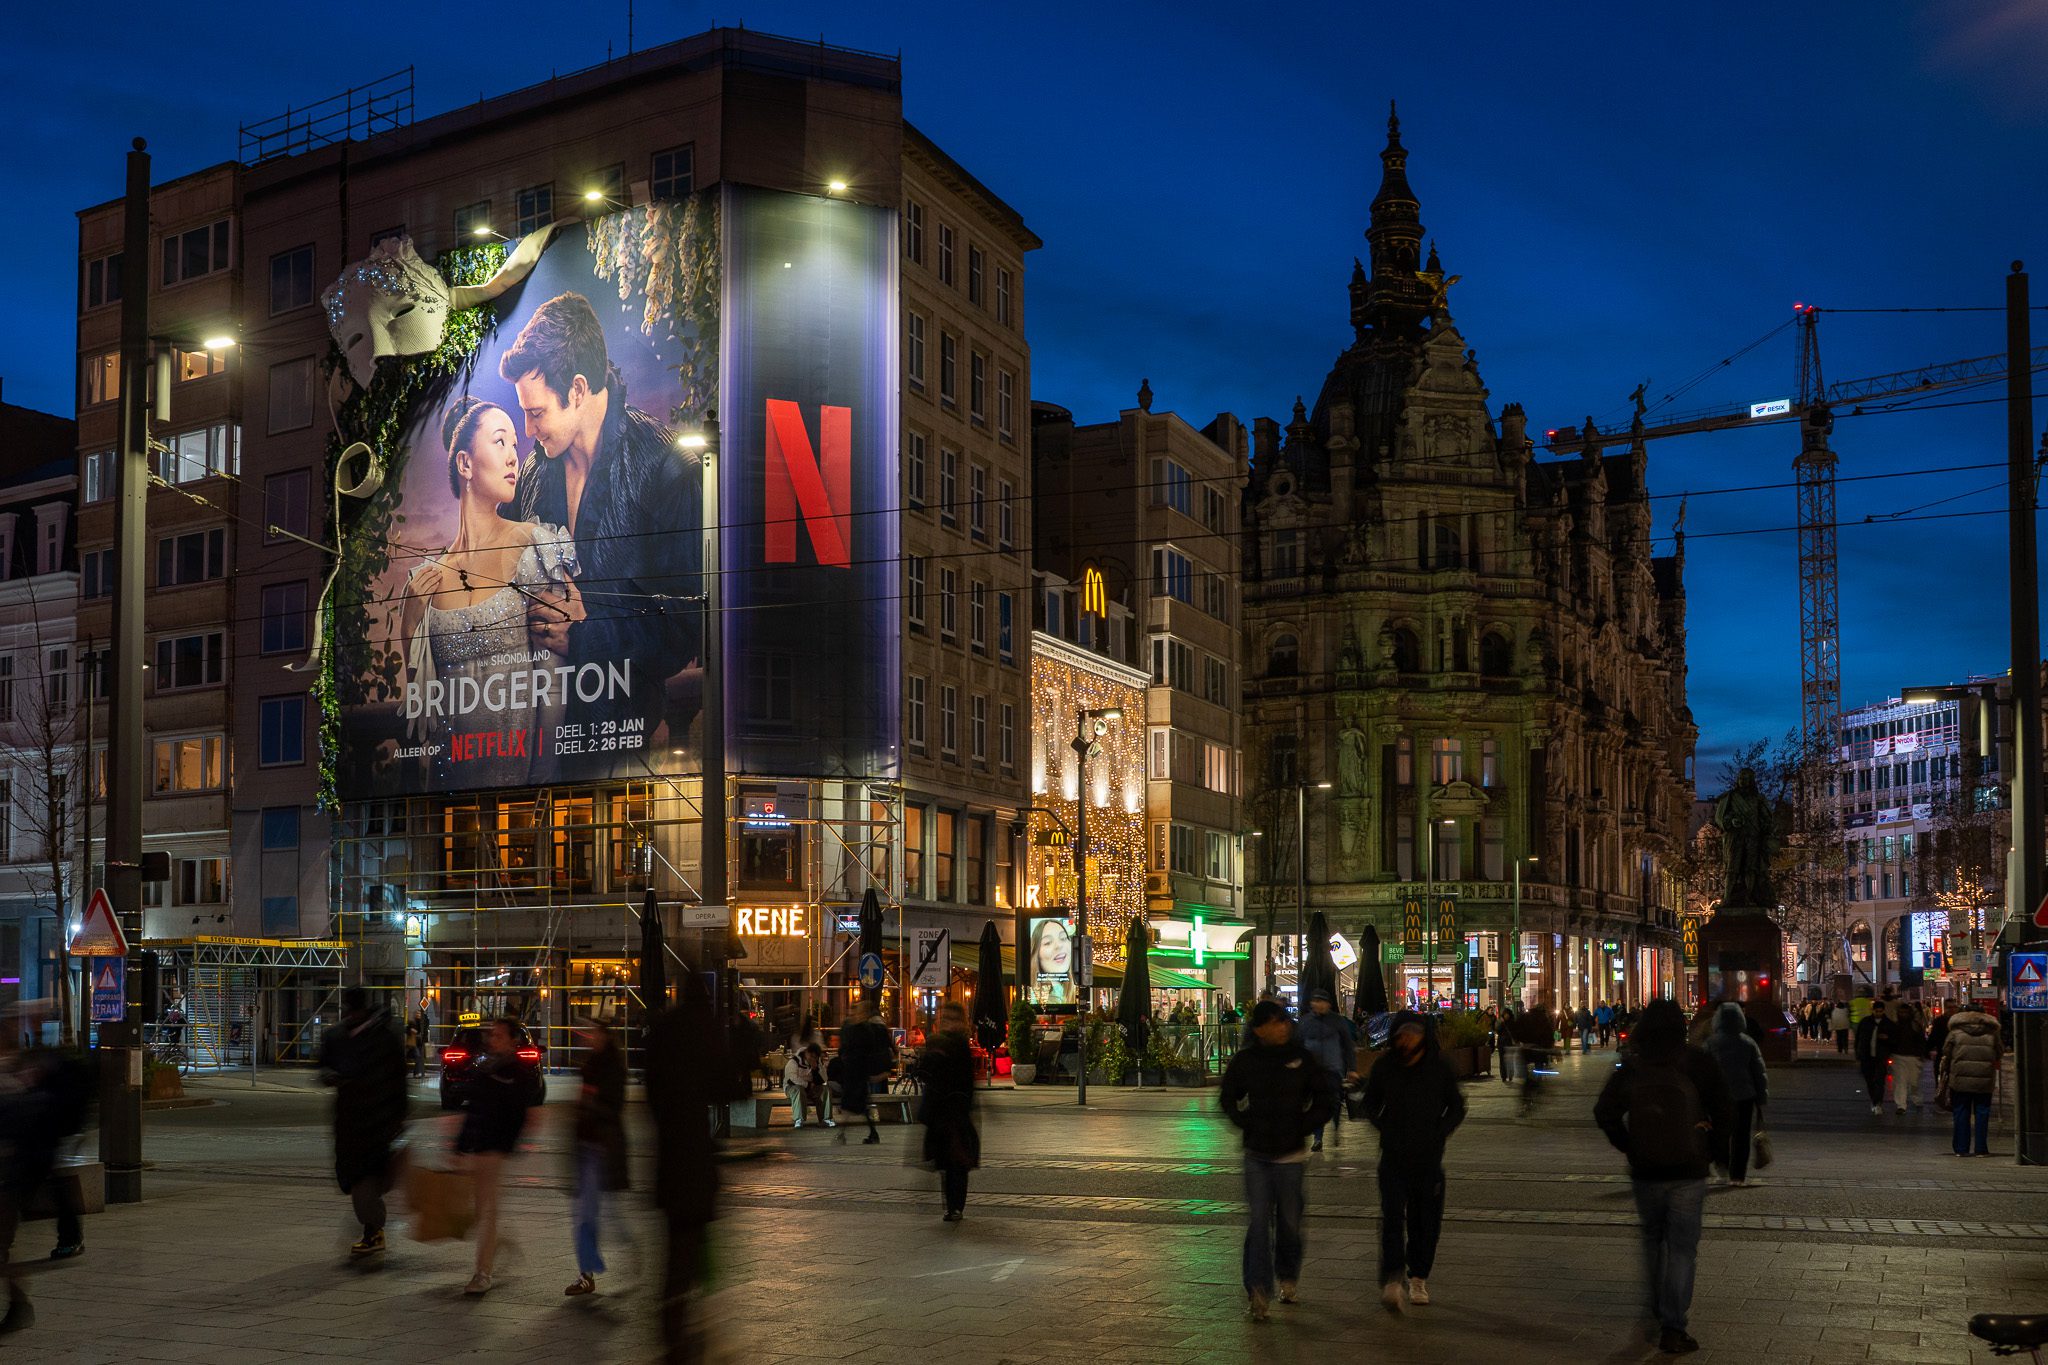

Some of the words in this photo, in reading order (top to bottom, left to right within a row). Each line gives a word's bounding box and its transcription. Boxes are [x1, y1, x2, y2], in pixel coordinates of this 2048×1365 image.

[1767, 404, 1785, 412] BESIX
[476, 659, 488, 667] VAN
[491, 649, 551, 666] SHONDALAND
[406, 658, 631, 719] BRIDGERTON
[555, 723, 586, 739] DEEL
[589, 722, 599, 736] 1:
[600, 720, 617, 735] 29
[618, 717, 645, 733] JAN
[393, 747, 426, 758] ALLEEN
[428, 745, 441, 756] OP
[451, 728, 527, 763] NETFLIX
[554, 740, 586, 755] DEEL
[587, 738, 599, 752] 2:
[600, 736, 617, 751] 26
[618, 734, 643, 749] FEB
[918, 930, 940, 939] ZONE
[95, 1003, 120, 1015] TRAM
